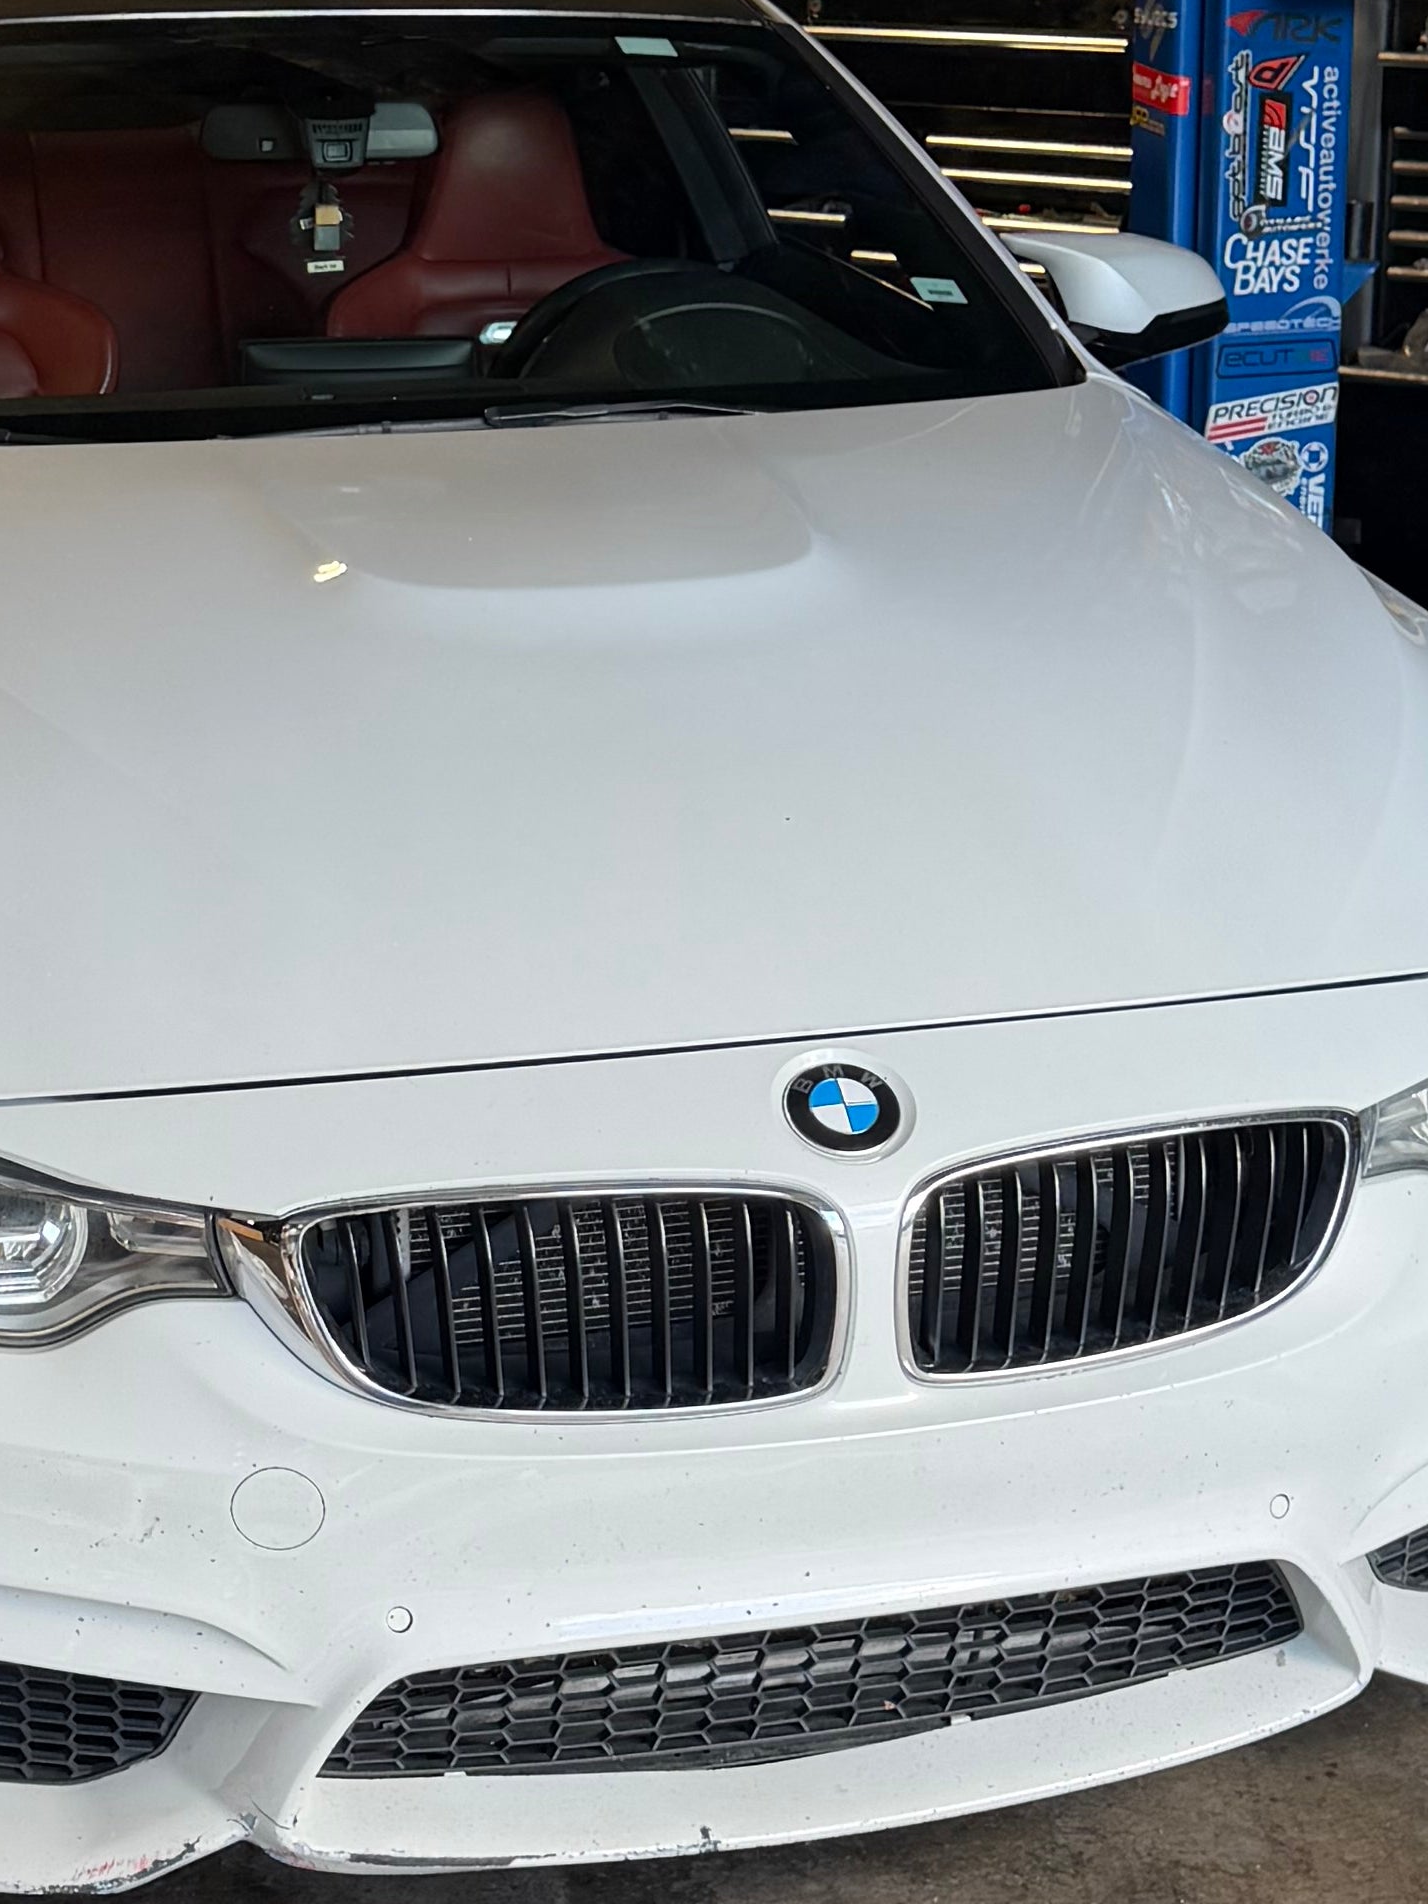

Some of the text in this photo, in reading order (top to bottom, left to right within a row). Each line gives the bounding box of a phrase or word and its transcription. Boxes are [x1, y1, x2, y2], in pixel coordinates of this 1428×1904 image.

[1312, 65, 1343, 291] activeautowerke
[1224, 232, 1314, 270] CHASE
[1233, 260, 1301, 296] BAYS
[791, 1062, 885, 1095] BMW
